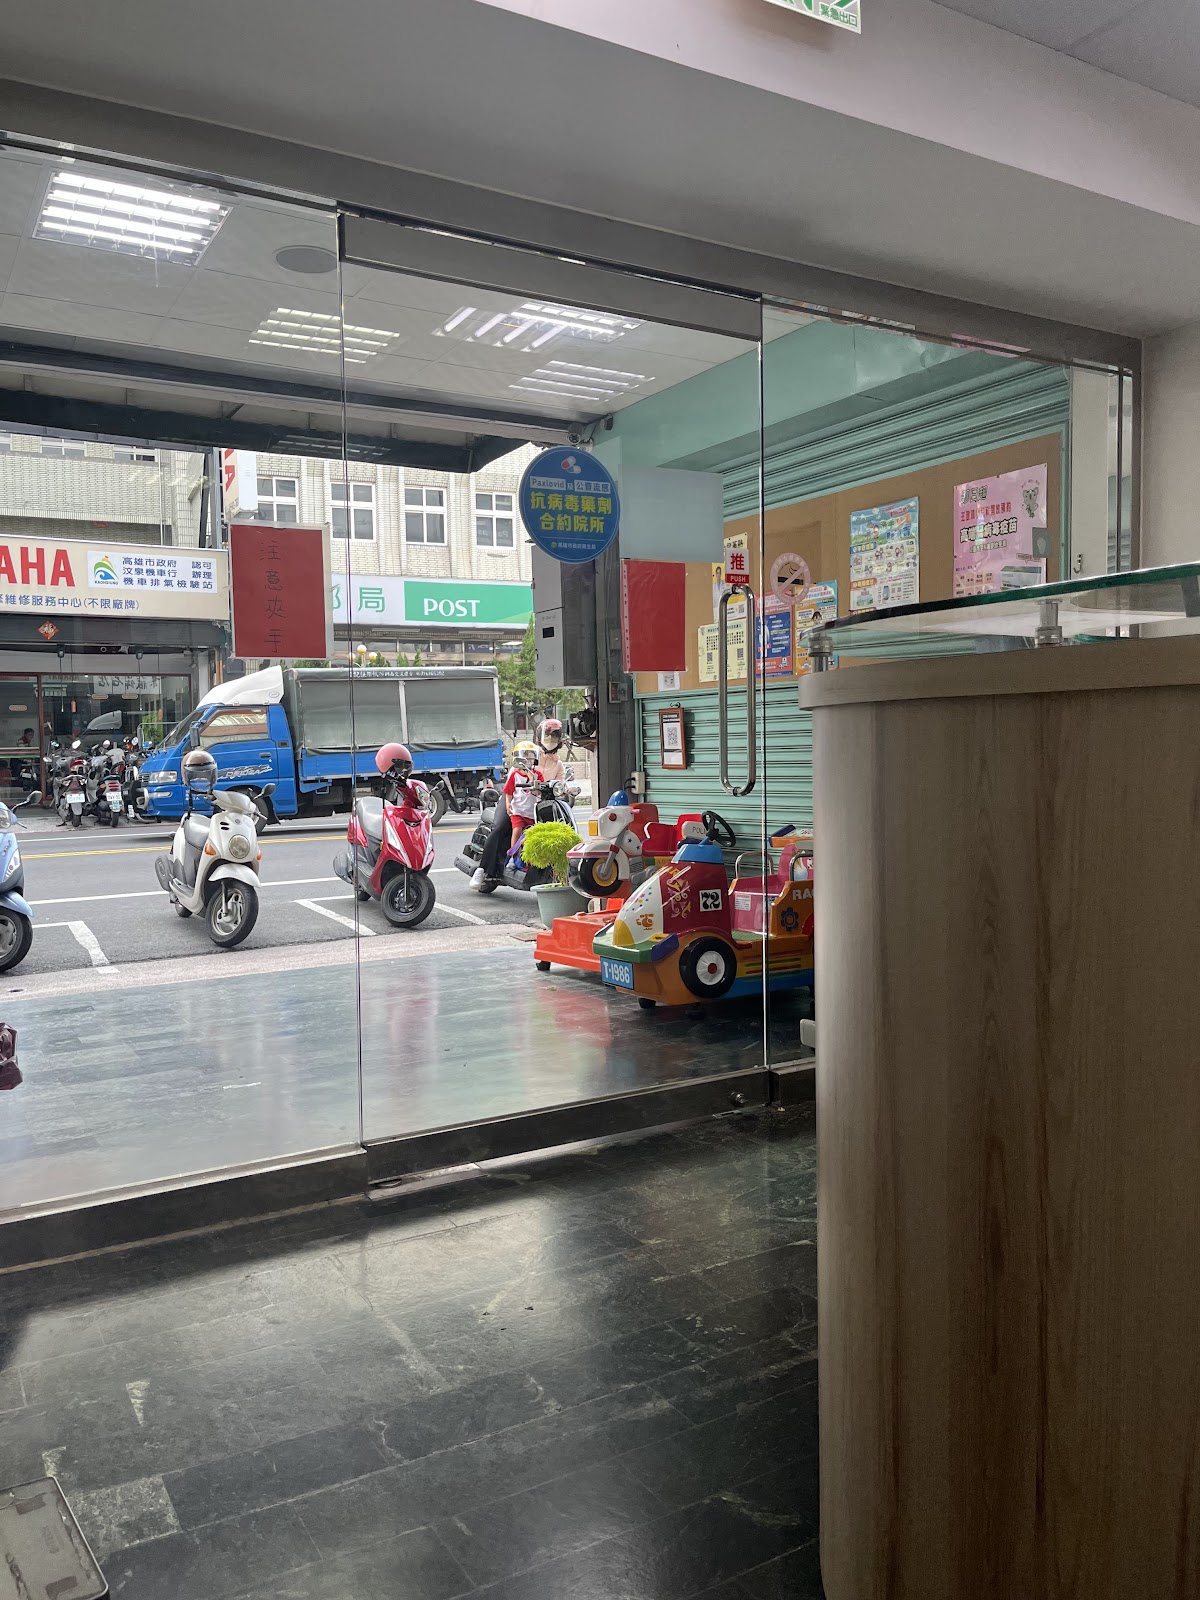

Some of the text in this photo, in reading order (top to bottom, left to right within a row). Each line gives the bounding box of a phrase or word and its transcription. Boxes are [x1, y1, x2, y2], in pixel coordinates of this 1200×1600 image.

[820, 2, 858, 28] 緊急出口
[531, 478, 565, 489] Paxlovid
[530, 491, 612, 515] 抗病毒藥劑
[540, 512, 605, 534] 合約院所
[0, 545, 76, 587] AHA
[122, 556, 212, 570] 高雄市政府 認可
[730, 553, 745, 571] 推
[123, 577, 213, 589] 機車排氣檢驗站
[192, 571, 213, 580] 辦理
[730, 575, 746, 583] PUSH
[0, 593, 140, 611] 維修服務中心(不限廠牌)
[259, 540, 286, 653] 注意夾手
[333, 585, 481, 617] 局 POST
[692, 826, 707, 835] POLI
[701, 891, 721, 910] 72
[603, 960, 631, 984] T-1986
